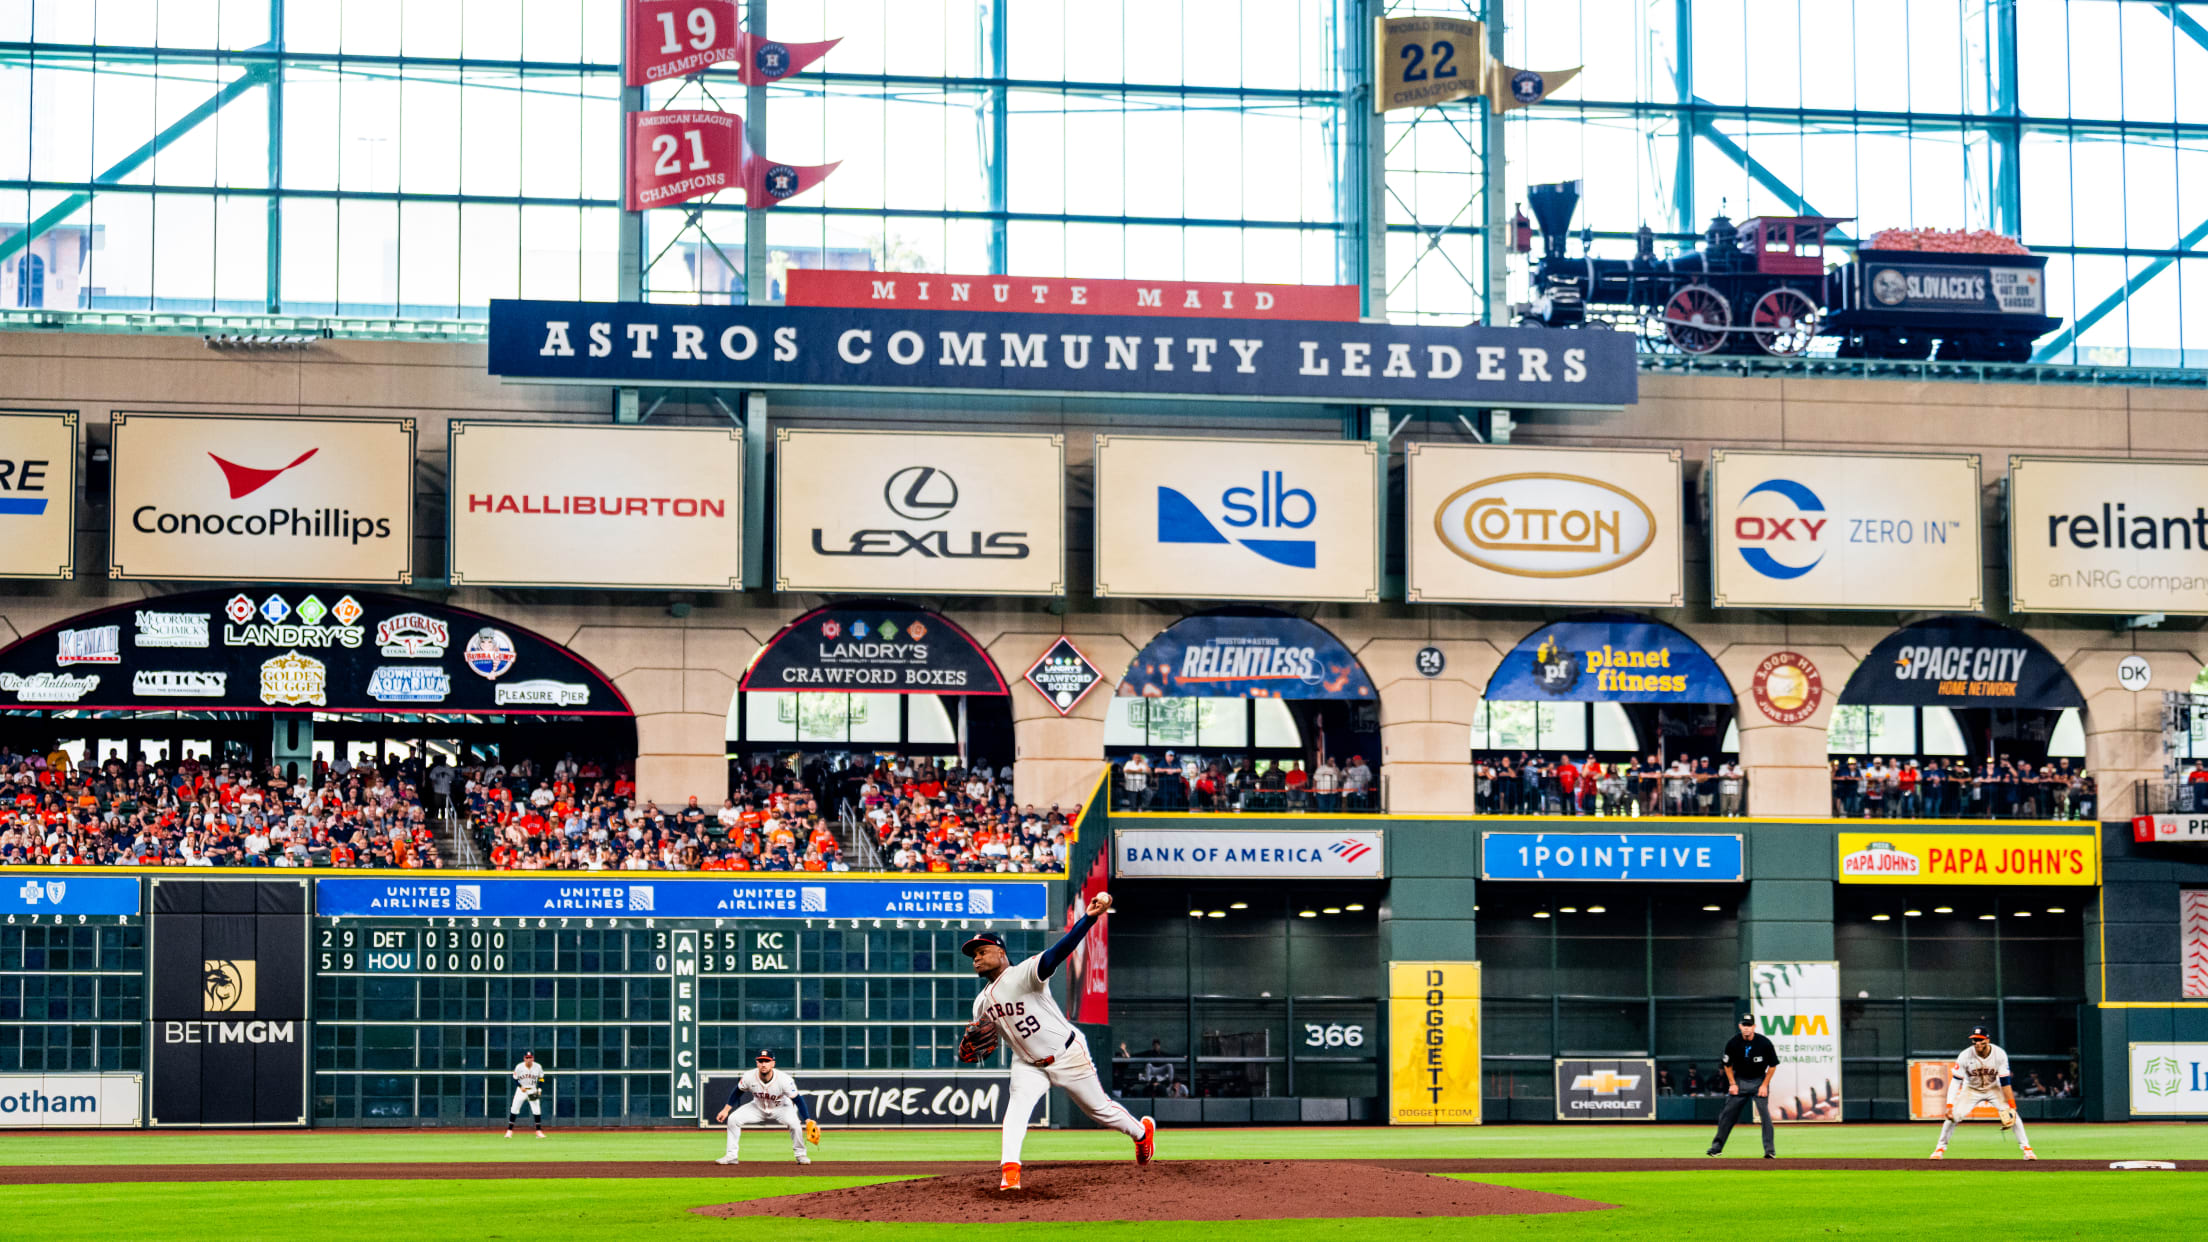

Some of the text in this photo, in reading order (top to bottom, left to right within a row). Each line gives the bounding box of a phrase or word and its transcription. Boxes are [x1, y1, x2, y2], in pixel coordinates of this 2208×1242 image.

[656, 8, 716, 54] 19
[1389, 22, 1474, 36] WORLD SERIES
[646, 49, 735, 80] CHAMPIONS
[1400, 41, 1457, 82] 22
[1394, 80, 1475, 104] CHAMPIONS
[638, 114, 733, 127] AMERICAN LEAGUE
[652, 130, 710, 176] 21
[639, 173, 726, 203] CHAMPIONS
[872, 280, 1274, 310] MINUTE MAID
[1907, 275, 1986, 301] SLOVACEK'S
[539, 321, 1588, 383] ASTROS COMMUNITY LEADERS
[468, 494, 725, 518] HALLIBURTON
[1222, 470, 1317, 529] slb
[132, 506, 391, 545] ConocoPhillips
[1463, 496, 1621, 555] COTTON
[1735, 516, 1828, 542] OXY
[1850, 519, 1913, 544] ZERO
[2048, 502, 2208, 551] reliant
[811, 528, 1030, 559] LEXUS
[2048, 570, 2208, 595] an NRG compan
[226, 627, 362, 645] LANDRY'S
[379, 615, 447, 643] SALTGRASS
[819, 643, 928, 659] LANDRY'S
[1419, 652, 1441, 667] 24
[1586, 645, 1670, 673] planet
[1181, 646, 1315, 678] RELENTLESS
[1798, 658, 1818, 679] HIT
[1896, 646, 2027, 683] SPACE CITY
[263, 671, 323, 681] GOLDEN
[379, 668, 442, 679] DOWNTOWN
[782, 667, 967, 686] CRAWFORD BOXES
[1036, 674, 1092, 683] CRAWFORD
[1544, 661, 1567, 683] pf
[2121, 665, 2147, 681] DK
[264, 682, 321, 692] NUGGET
[369, 671, 449, 695] AQUARIUM
[1048, 682, 1080, 691] BOXES
[1938, 681, 2016, 697] HOME NETWORK
[498, 690, 585, 702] PLEASURE PIER
[1759, 701, 1782, 720] JUNE
[1127, 848, 1323, 863] BANK OF AMERICA
[1518, 846, 1712, 868] 1POINTFIVE
[1846, 854, 1917, 872] PAPA JOHN'S
[1929, 848, 2084, 874] PAPA JOHN'S
[387, 887, 451, 897] UNITED
[560, 888, 624, 898] UNITED
[733, 889, 796, 899] UNITED
[901, 891, 964, 900] UNITED
[371, 898, 451, 909] AIRLINES
[543, 899, 624, 909] AIRLINES
[717, 900, 796, 910] AIRLINES
[886, 902, 964, 912] AIRLINES
[7, 915, 128, 924] 6 7 8 9 R
[332, 918, 654, 928] P 1 2 3 4 5 6 7 8 9 R
[716, 919, 1030, 929] P 1 2 3 4 5 6 7 8 9 R
[373, 932, 406, 948] DET
[426, 932, 437, 948] 0
[449, 932, 459, 949] 3
[471, 932, 482, 949] 0
[494, 932, 504, 949] 0
[656, 932, 667, 949] 3
[756, 932, 784, 949] KC
[368, 953, 411, 970] HOU
[426, 953, 437, 971] 0
[448, 954, 459, 971] 0
[470, 954, 481, 971] 0
[494, 954, 504, 971] 0
[656, 954, 667, 971] 0
[751, 953, 789, 971] BAL
[166, 1020, 294, 1043] BETMGM
[676, 936, 695, 1113] AMERICAN
[1014, 1014, 1041, 1039] 59
[1760, 1015, 1830, 1036] WM
[1305, 1023, 1364, 1048] 366
[1426, 969, 1444, 1104] DOGGETT
[1794, 1044, 1833, 1053] DRIVING
[1778, 1056, 1834, 1064] TAINABILITY
[1398, 1108, 1472, 1118] DOGGETT.COM
[1570, 1100, 1643, 1110] CHEVROLET
